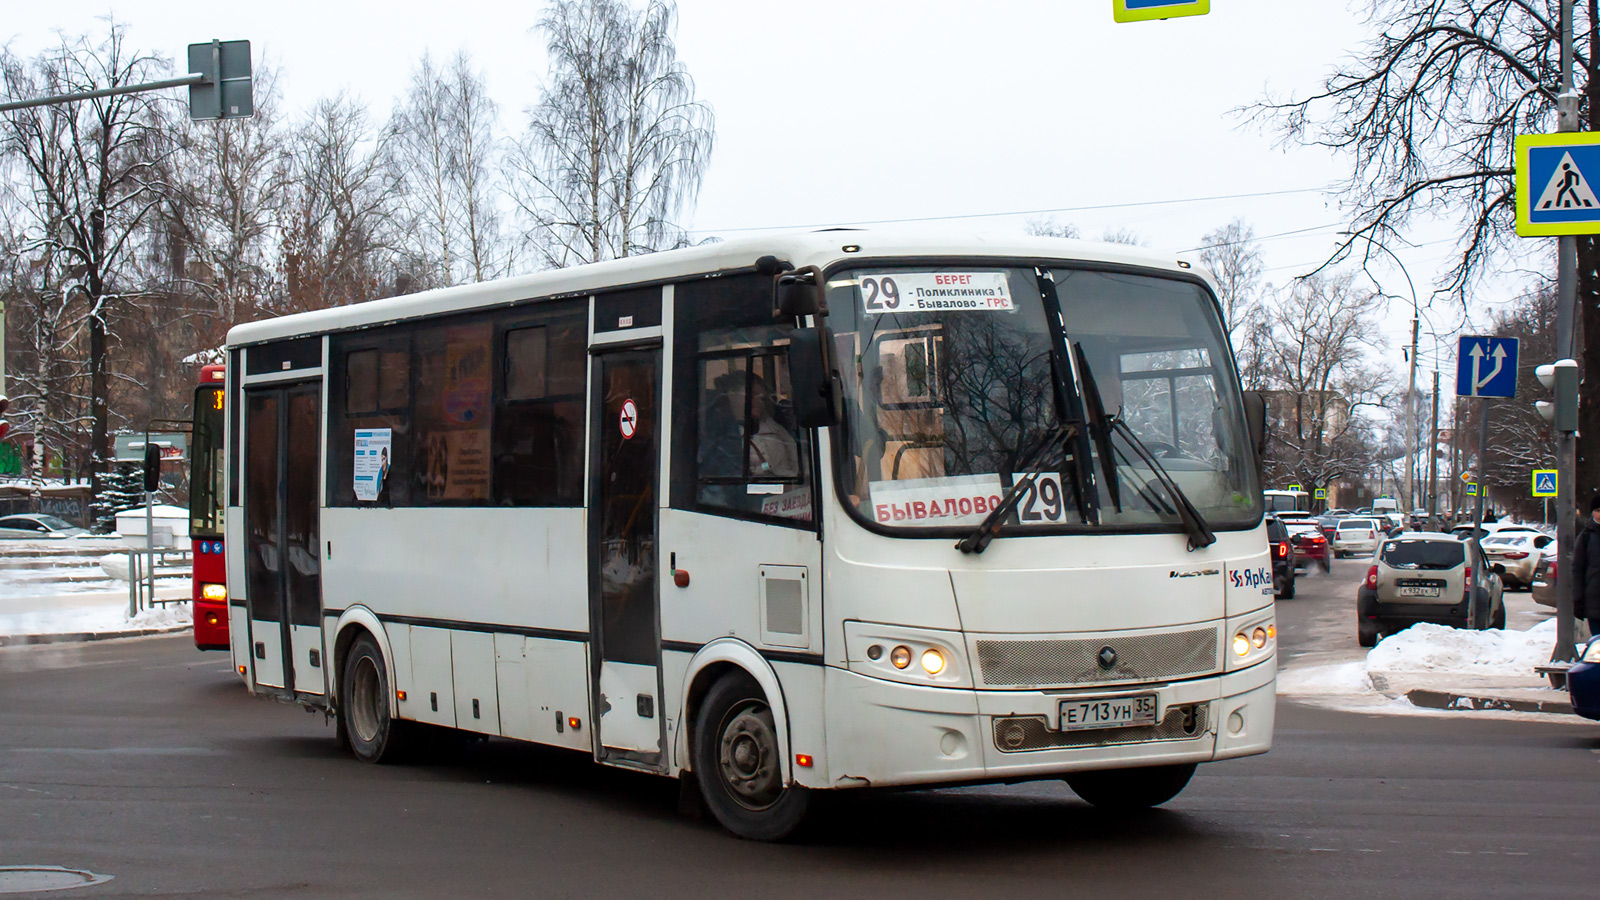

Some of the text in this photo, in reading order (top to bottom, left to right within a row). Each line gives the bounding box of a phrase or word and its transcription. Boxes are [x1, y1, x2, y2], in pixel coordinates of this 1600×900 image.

[935, 275, 972, 285] БЕРЕГ
[861, 276, 900, 310] 29
[916, 287, 995, 298] Поликлиника
[997, 287, 1003, 296] 1
[918, 299, 977, 309] Бывалово
[986, 298, 1009, 308] ГРС
[213, 390, 224, 410] 3
[764, 500, 778, 515] БЕЗ
[876, 494, 1001, 523] БЫВАЛОВО
[1021, 477, 1062, 522] 29
[1067, 698, 1150, 723] Е713УН 35
